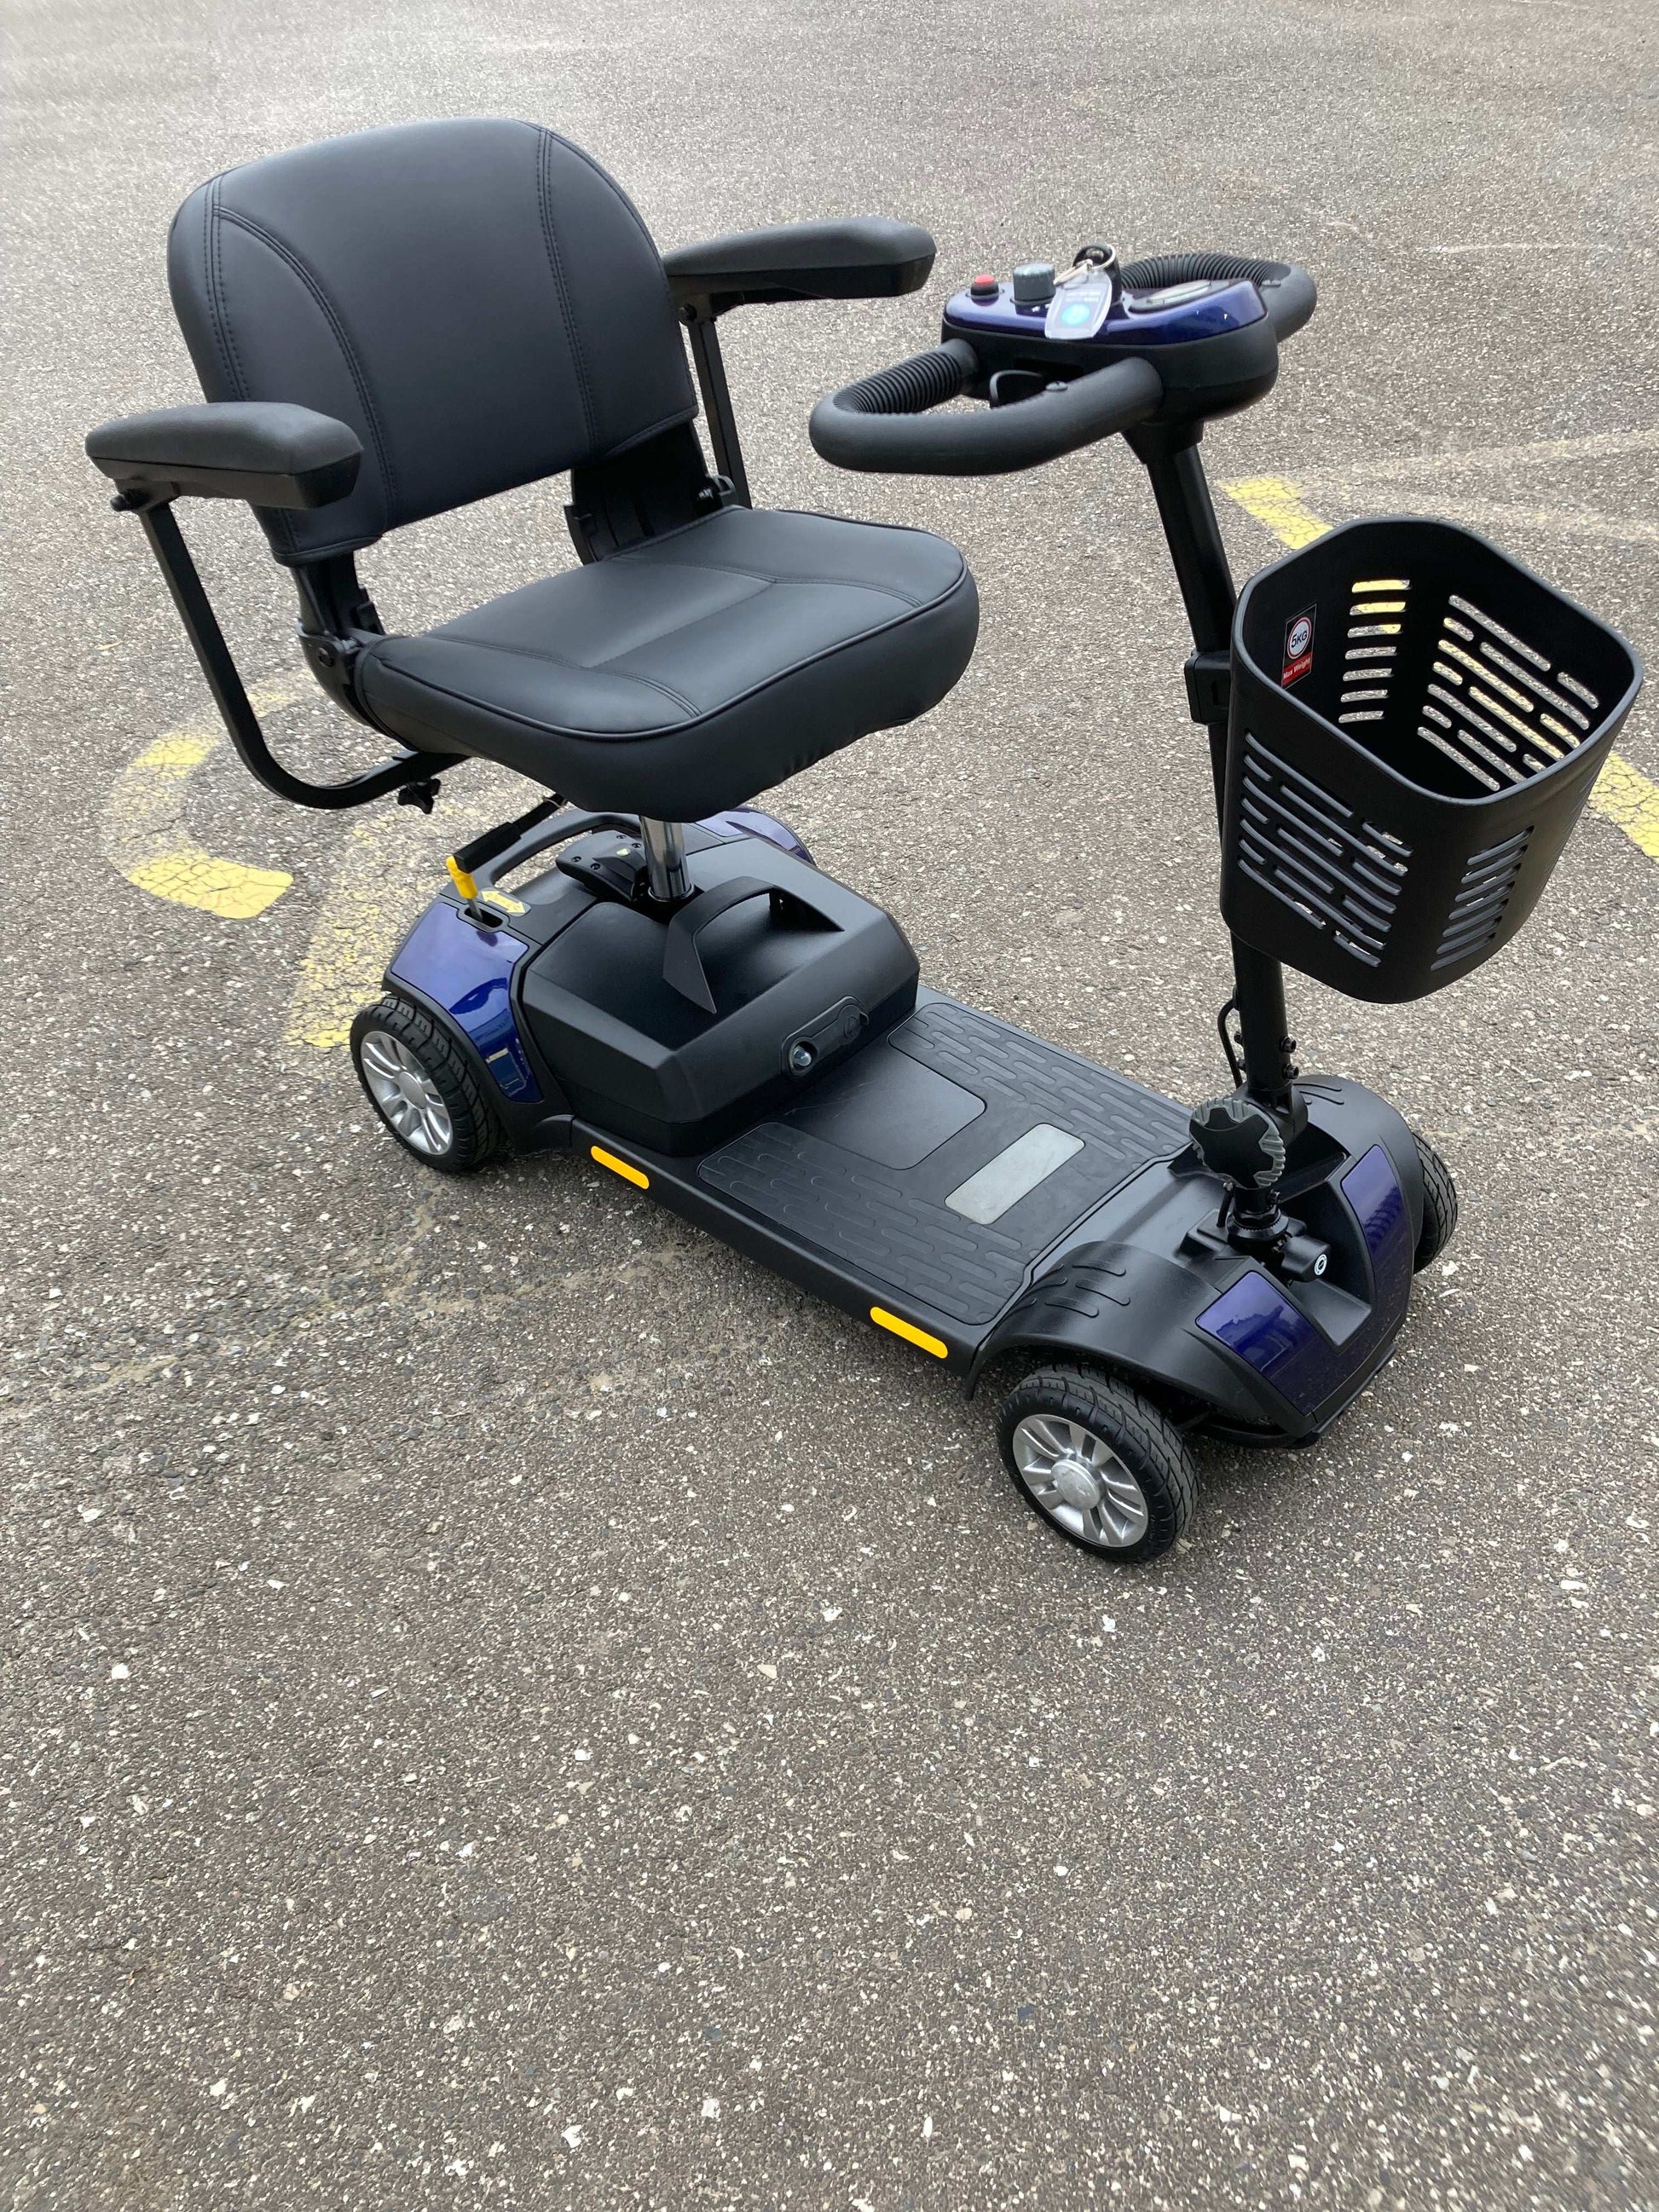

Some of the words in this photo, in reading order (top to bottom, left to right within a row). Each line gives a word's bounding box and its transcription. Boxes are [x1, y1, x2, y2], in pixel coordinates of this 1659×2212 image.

[1291, 631, 1307, 648] 5KG
[1283, 670, 1293, 679] Max
[1294, 657, 1310, 673] Weight
